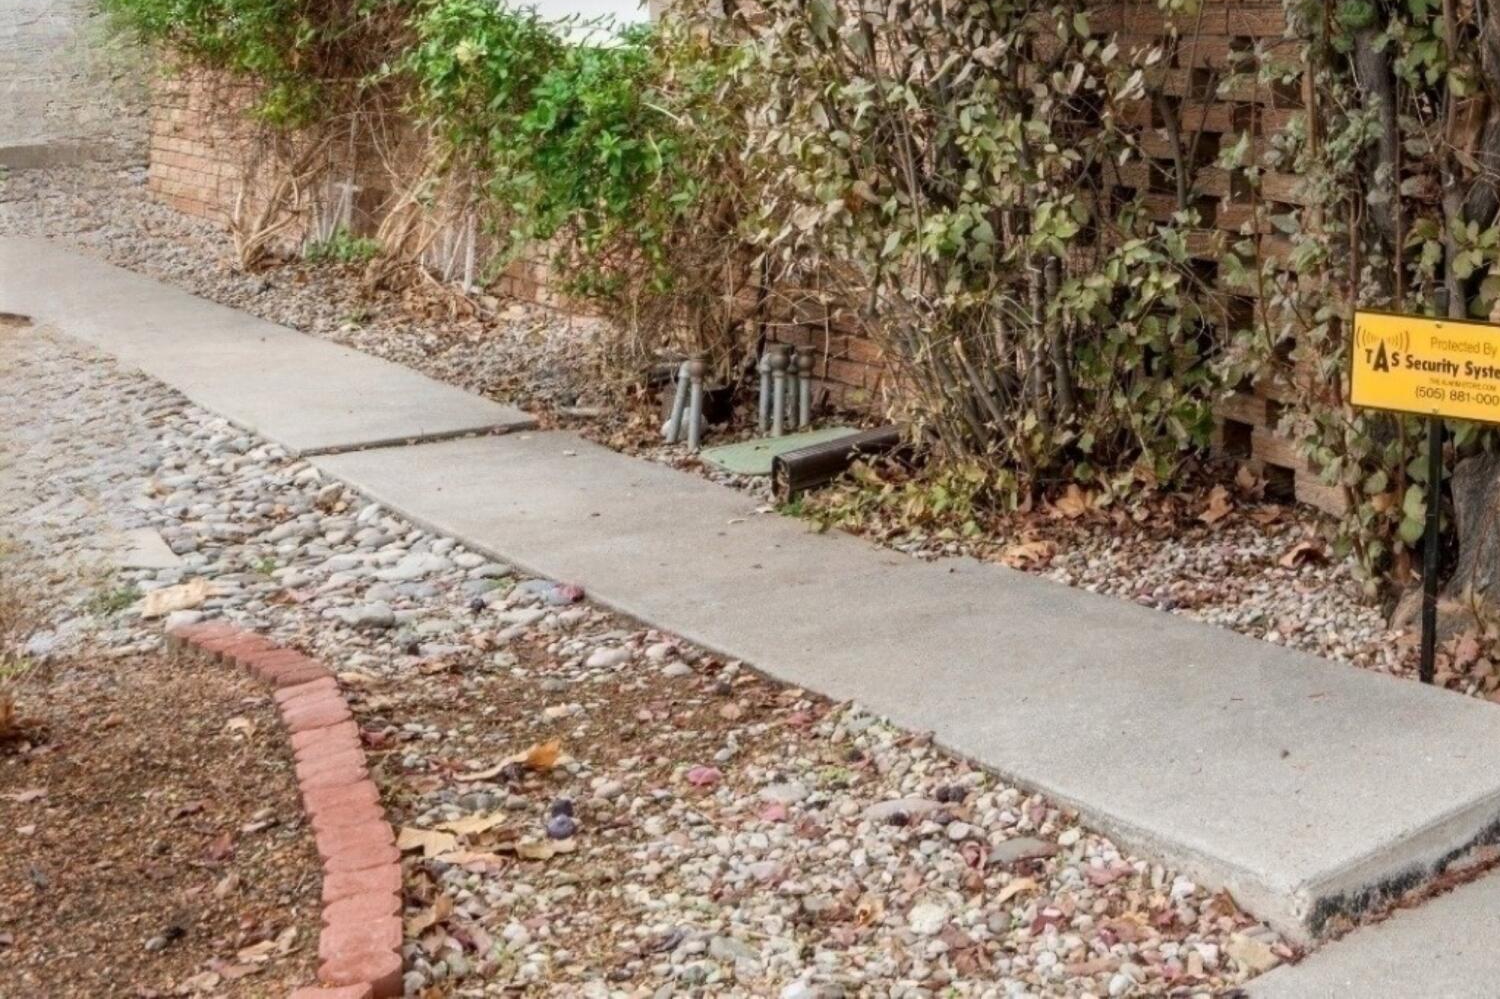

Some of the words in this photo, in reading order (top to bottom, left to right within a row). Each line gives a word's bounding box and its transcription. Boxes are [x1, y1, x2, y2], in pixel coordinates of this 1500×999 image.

[1365, 338, 1400, 373] TAS
[1405, 354, 1460, 378] Security
[1430, 336, 1480, 354] Protected
[1483, 341, 1498, 359] By
[1415, 386, 1445, 401] (505)
